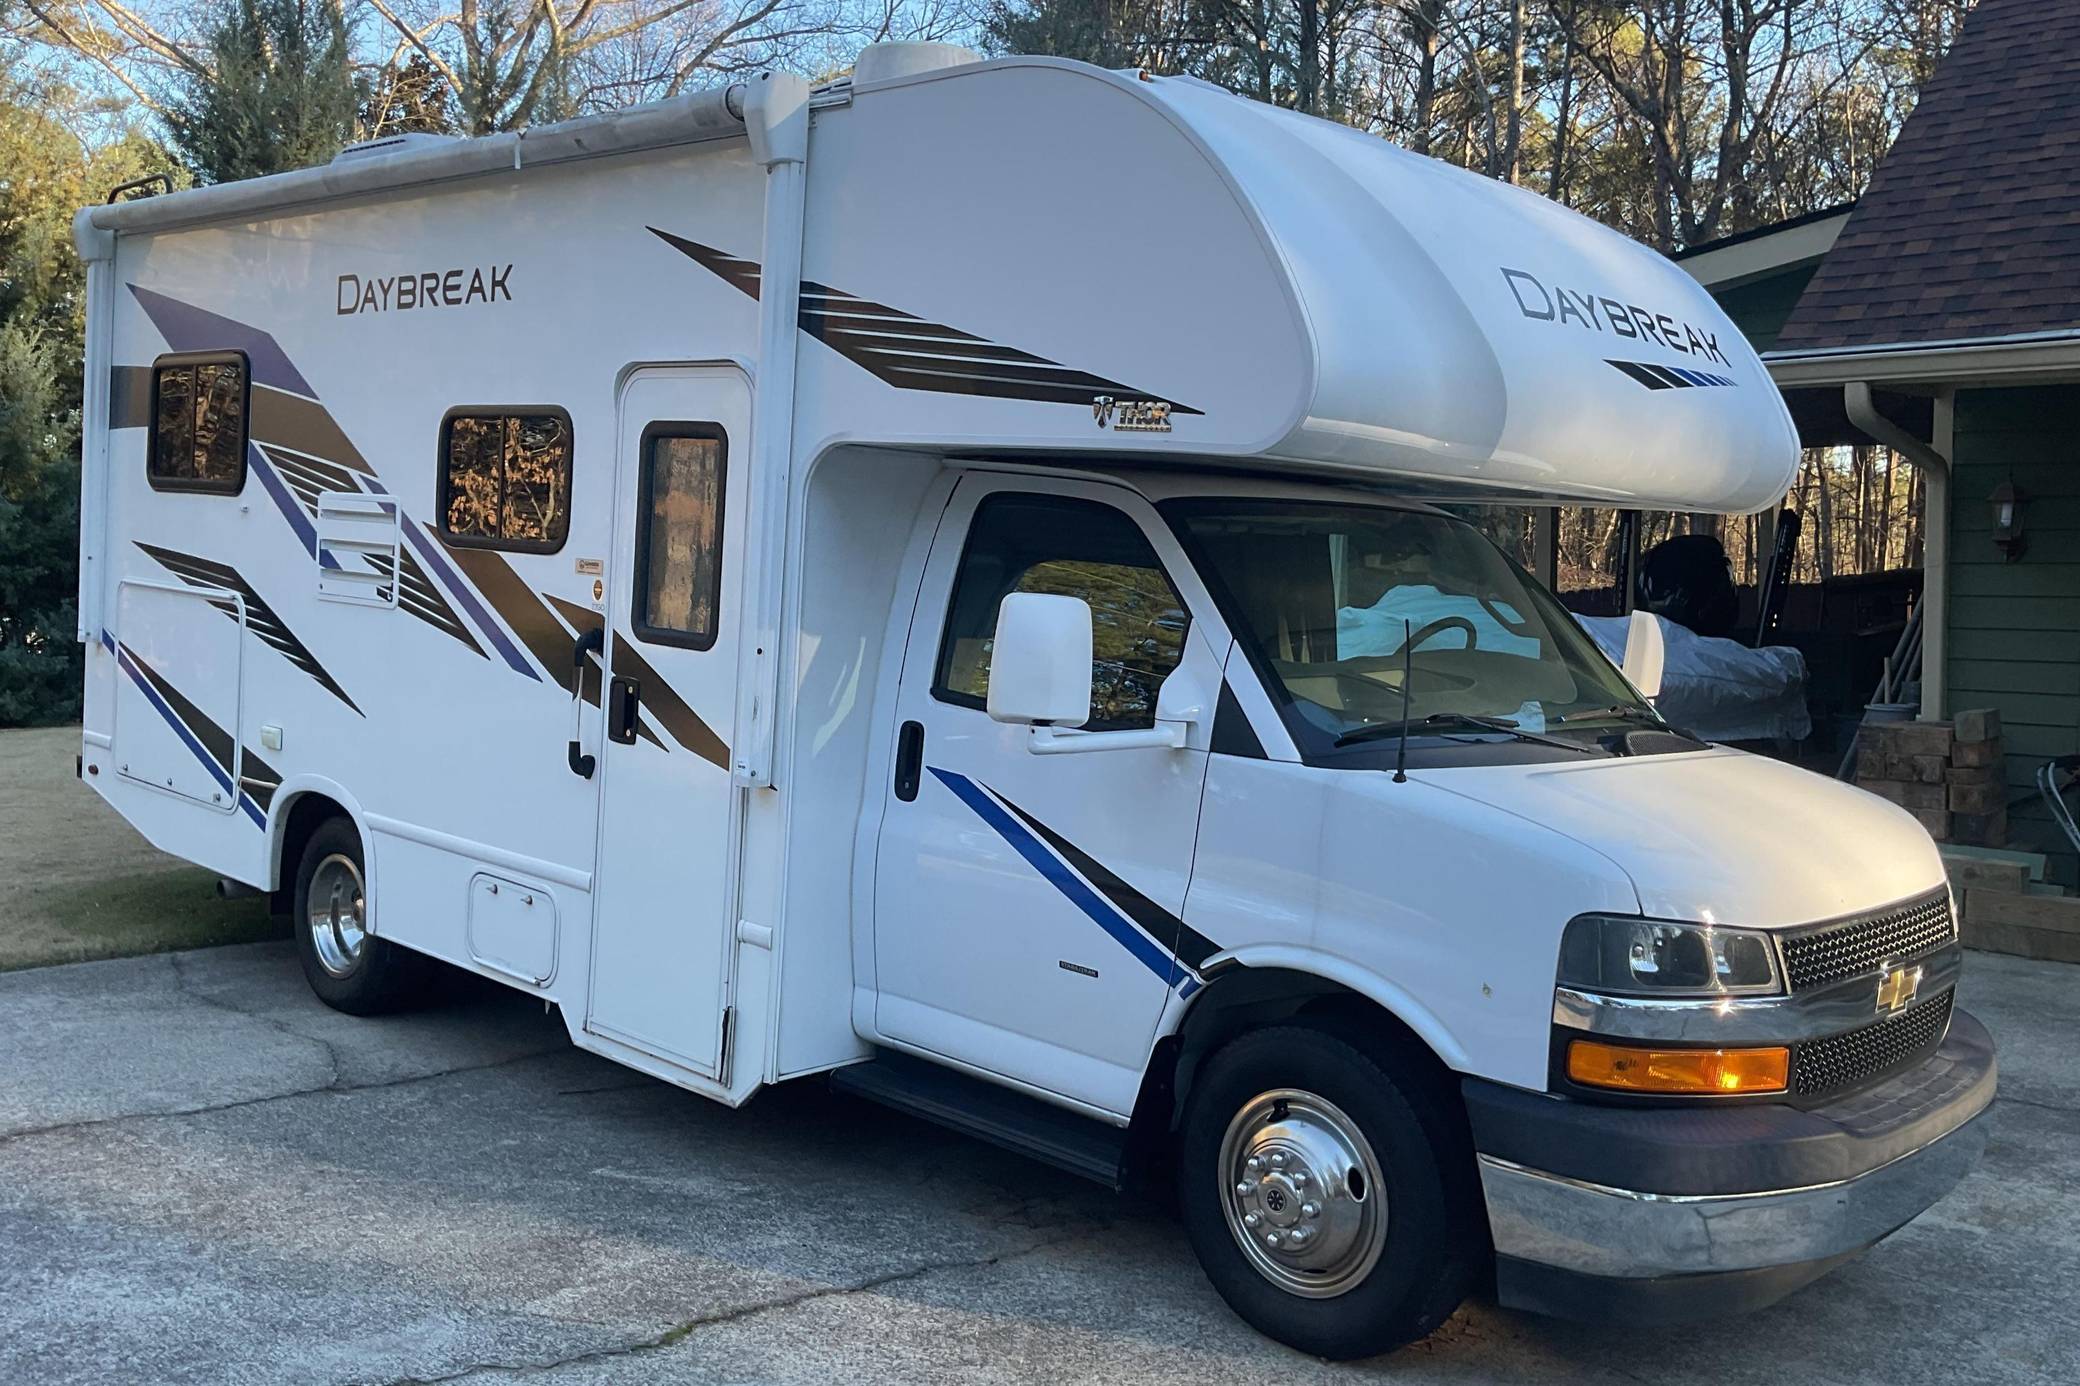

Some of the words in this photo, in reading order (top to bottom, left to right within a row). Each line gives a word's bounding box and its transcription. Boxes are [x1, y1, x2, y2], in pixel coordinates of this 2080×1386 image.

[337, 264, 513, 315] DAYBREAK
[1500, 267, 1732, 368] DAYBREAK
[1115, 401, 1172, 425] THOR
